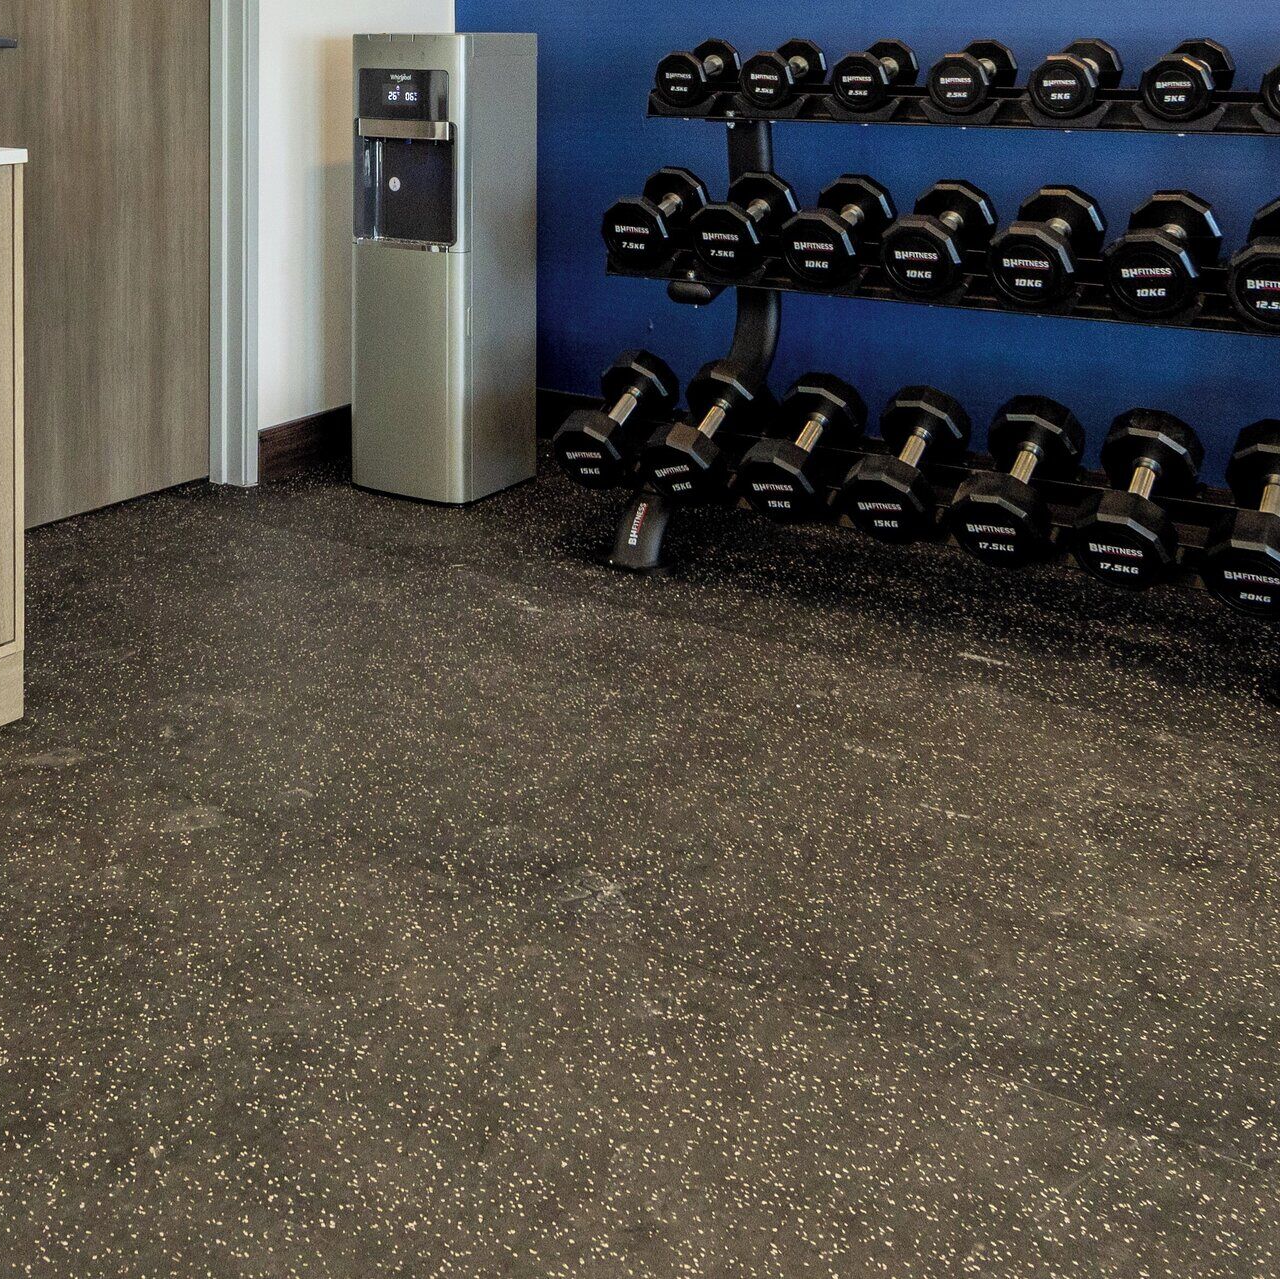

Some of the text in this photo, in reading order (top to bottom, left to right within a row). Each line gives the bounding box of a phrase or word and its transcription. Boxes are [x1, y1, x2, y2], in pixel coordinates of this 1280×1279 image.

[621, 241, 645, 250] 7.5KG
[710, 249, 735, 258] 7.5KG
[804, 260, 829, 269] 10KG
[906, 269, 932, 279] 10KG
[1015, 278, 1043, 288] 10KG
[1136, 288, 1166, 297] 10KG
[580, 467, 600, 475] 15KG
[671, 481, 692, 492] 15KG
[767, 500, 791, 509] 15KG
[873, 519, 899, 528] 15KG
[978, 541, 1015, 552] 17.5KG
[1099, 562, 1139, 575] 17.5KG
[1239, 591, 1271, 603] 20KG
